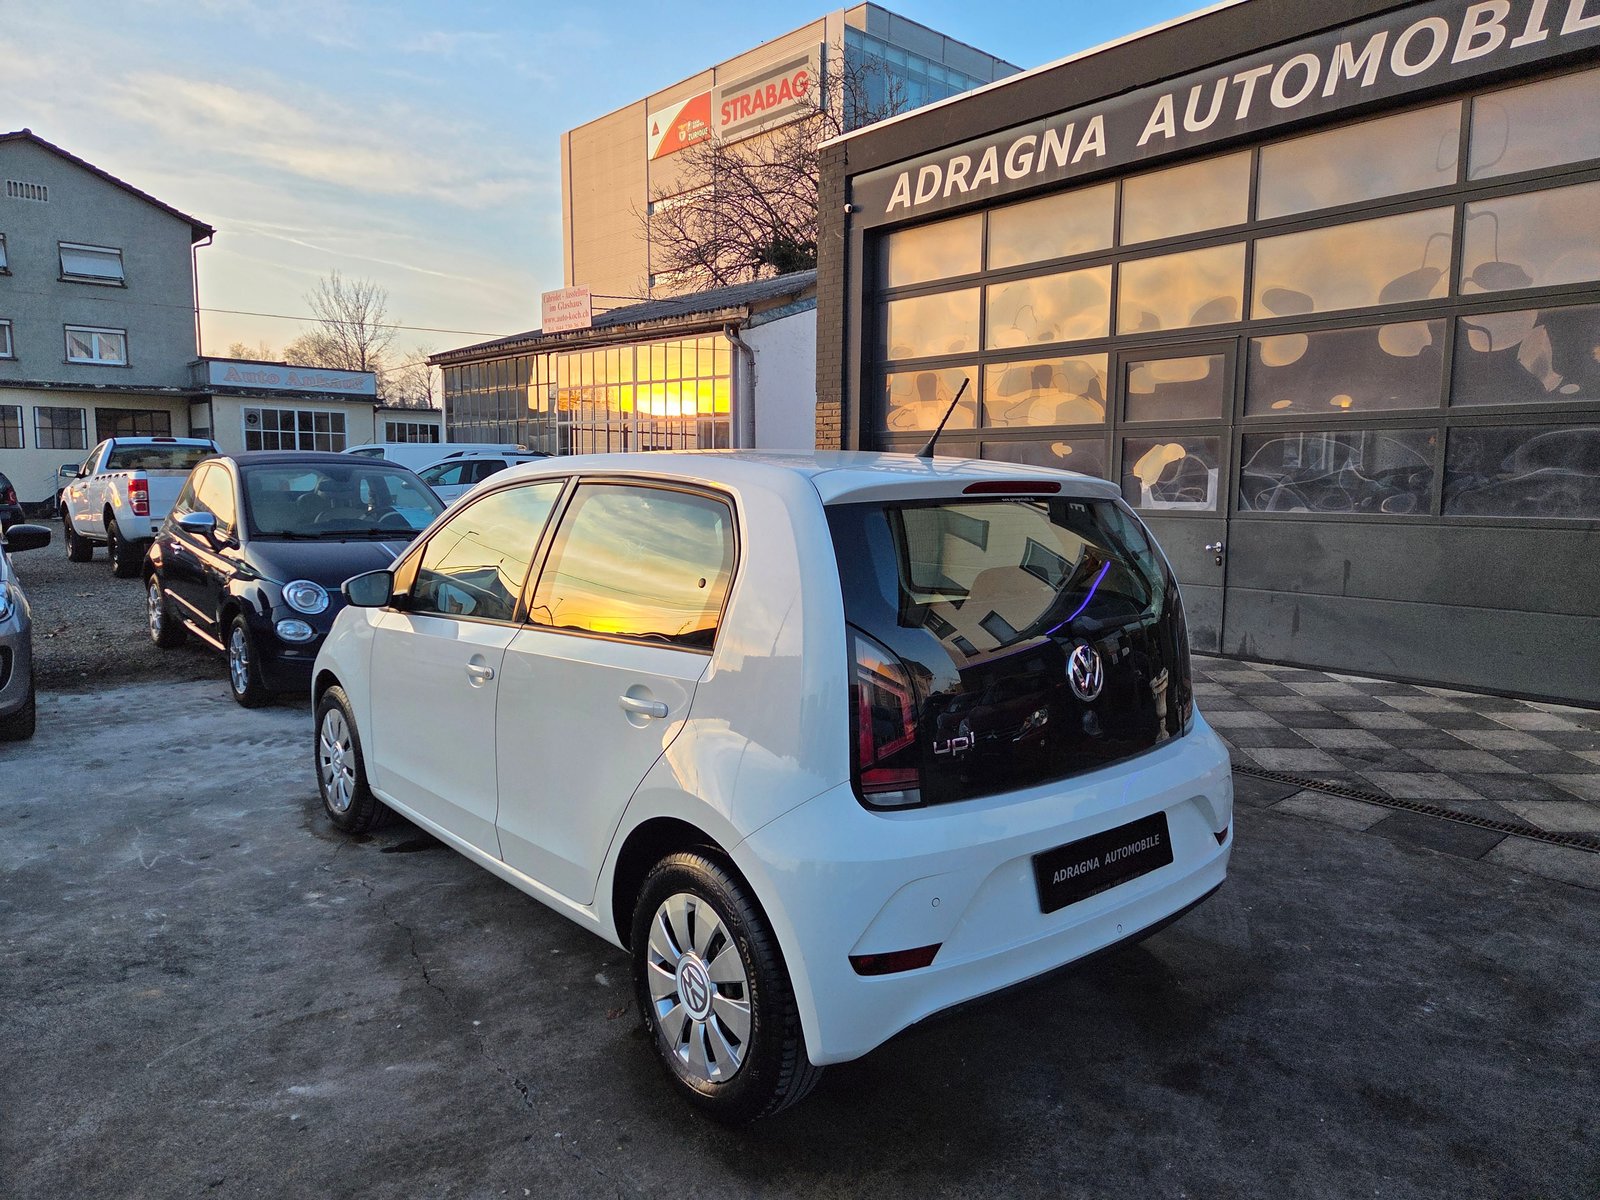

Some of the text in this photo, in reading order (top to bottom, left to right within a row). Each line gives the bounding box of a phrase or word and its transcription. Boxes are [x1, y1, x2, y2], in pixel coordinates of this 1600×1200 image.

[720, 70, 809, 126] STRABAG
[886, 114, 1106, 213] ADRAGNA
[223, 366, 280, 385] Auto
[932, 730, 976, 756] up!
[1052, 856, 1100, 885] ADRAGNA
[1104, 833, 1160, 866] AUTOMOBILE
